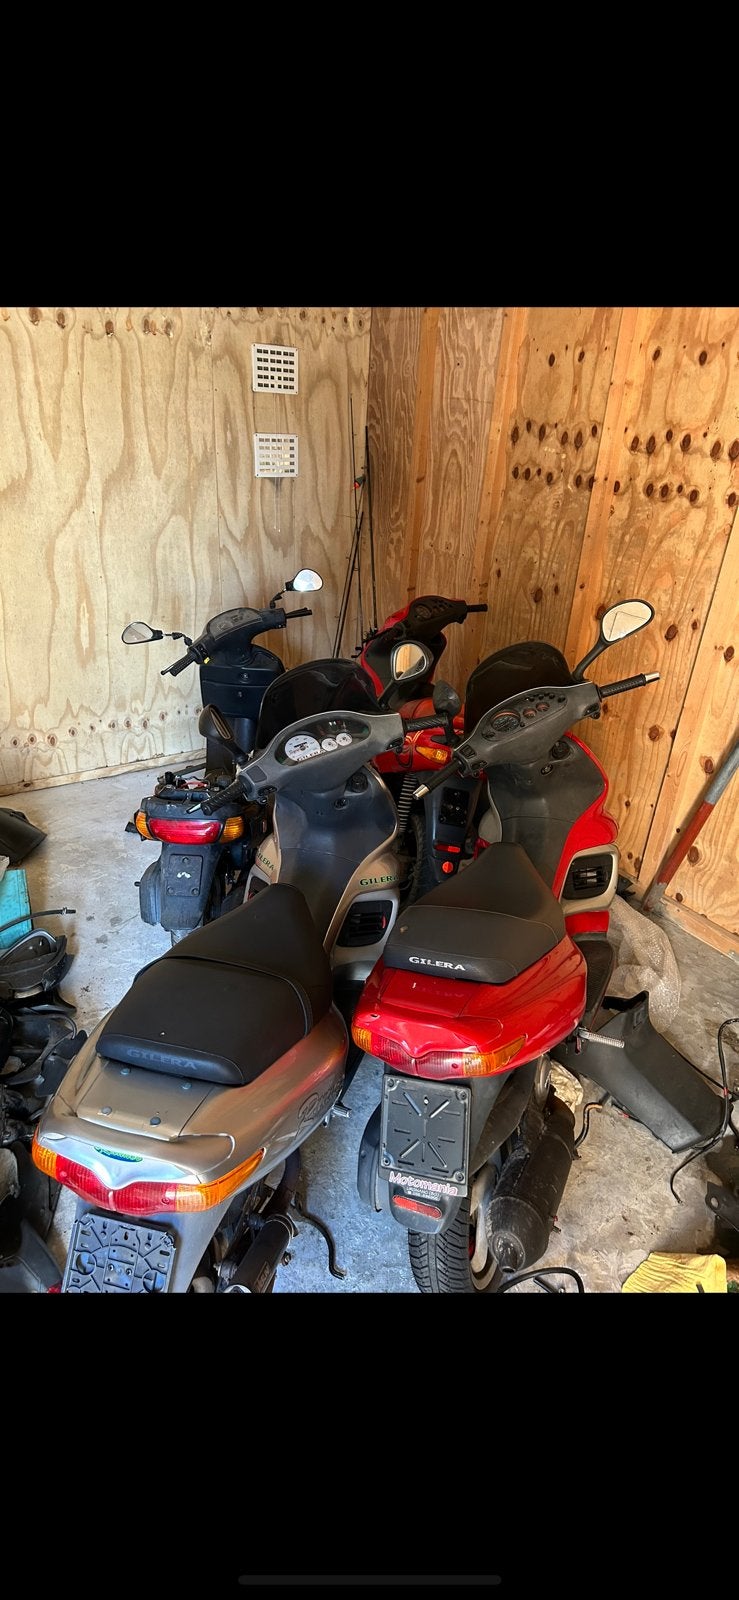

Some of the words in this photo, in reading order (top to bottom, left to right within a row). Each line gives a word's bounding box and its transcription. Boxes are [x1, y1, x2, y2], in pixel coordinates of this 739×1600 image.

[256, 851, 275, 871] ILERA
[408, 956, 466, 971] GILERA
[127, 1048, 197, 1070] GILERA
[388, 1171, 458, 1196] Motomania
